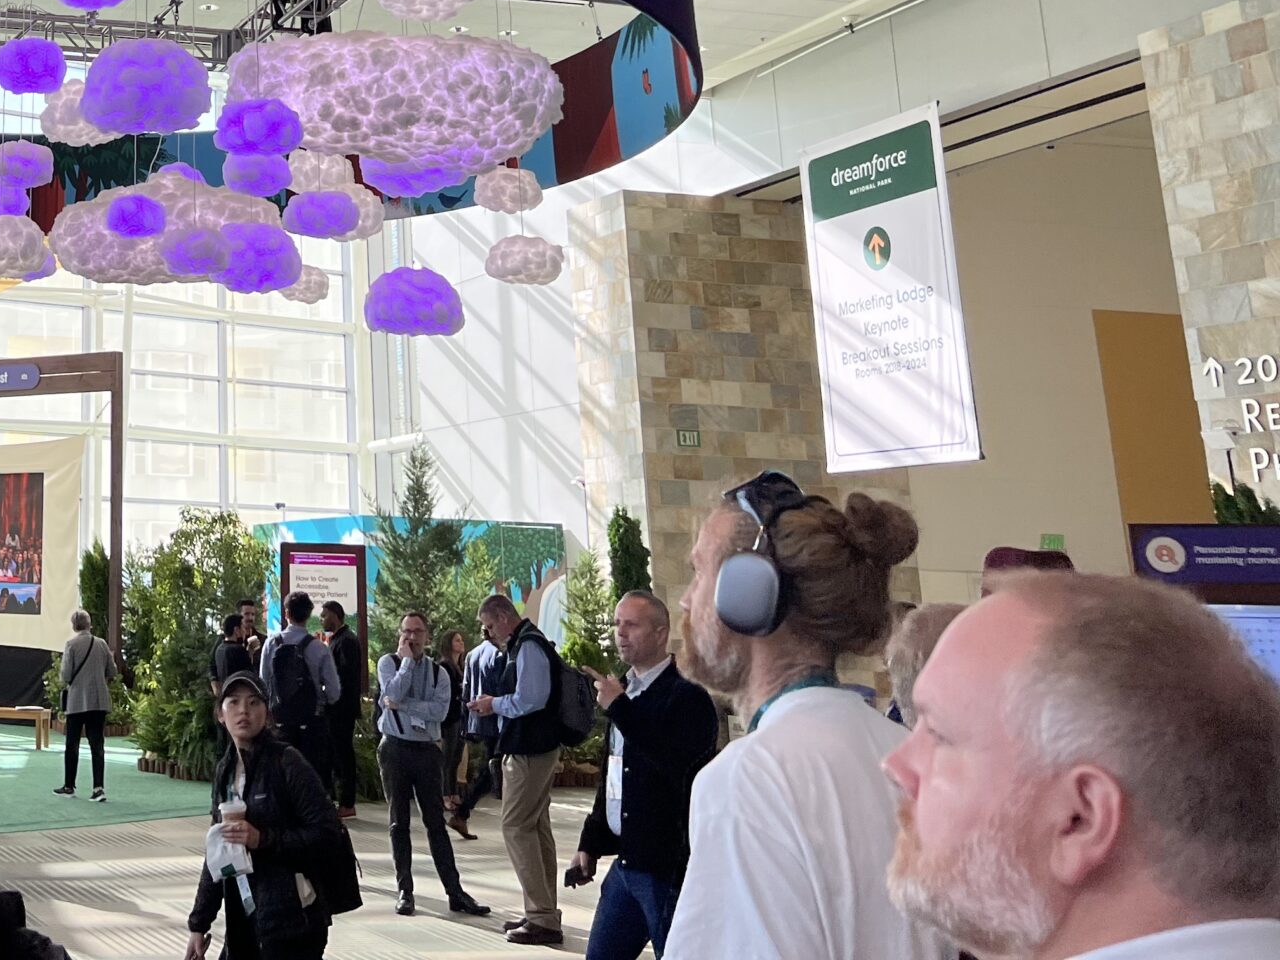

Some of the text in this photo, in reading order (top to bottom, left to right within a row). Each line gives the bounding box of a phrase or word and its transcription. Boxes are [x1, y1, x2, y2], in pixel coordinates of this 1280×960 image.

[831, 150, 907, 187] dreamforce
[849, 178, 892, 196] NATIONAL PARK
[838, 286, 934, 316] Marketing Lodge
[863, 315, 909, 336] Keynote
[842, 336, 944, 365] Breakout Sessions
[855, 368, 882, 379] Rooms
[1234, 354, 1279, 385] 20
[679, 430, 699, 447] EXIT
